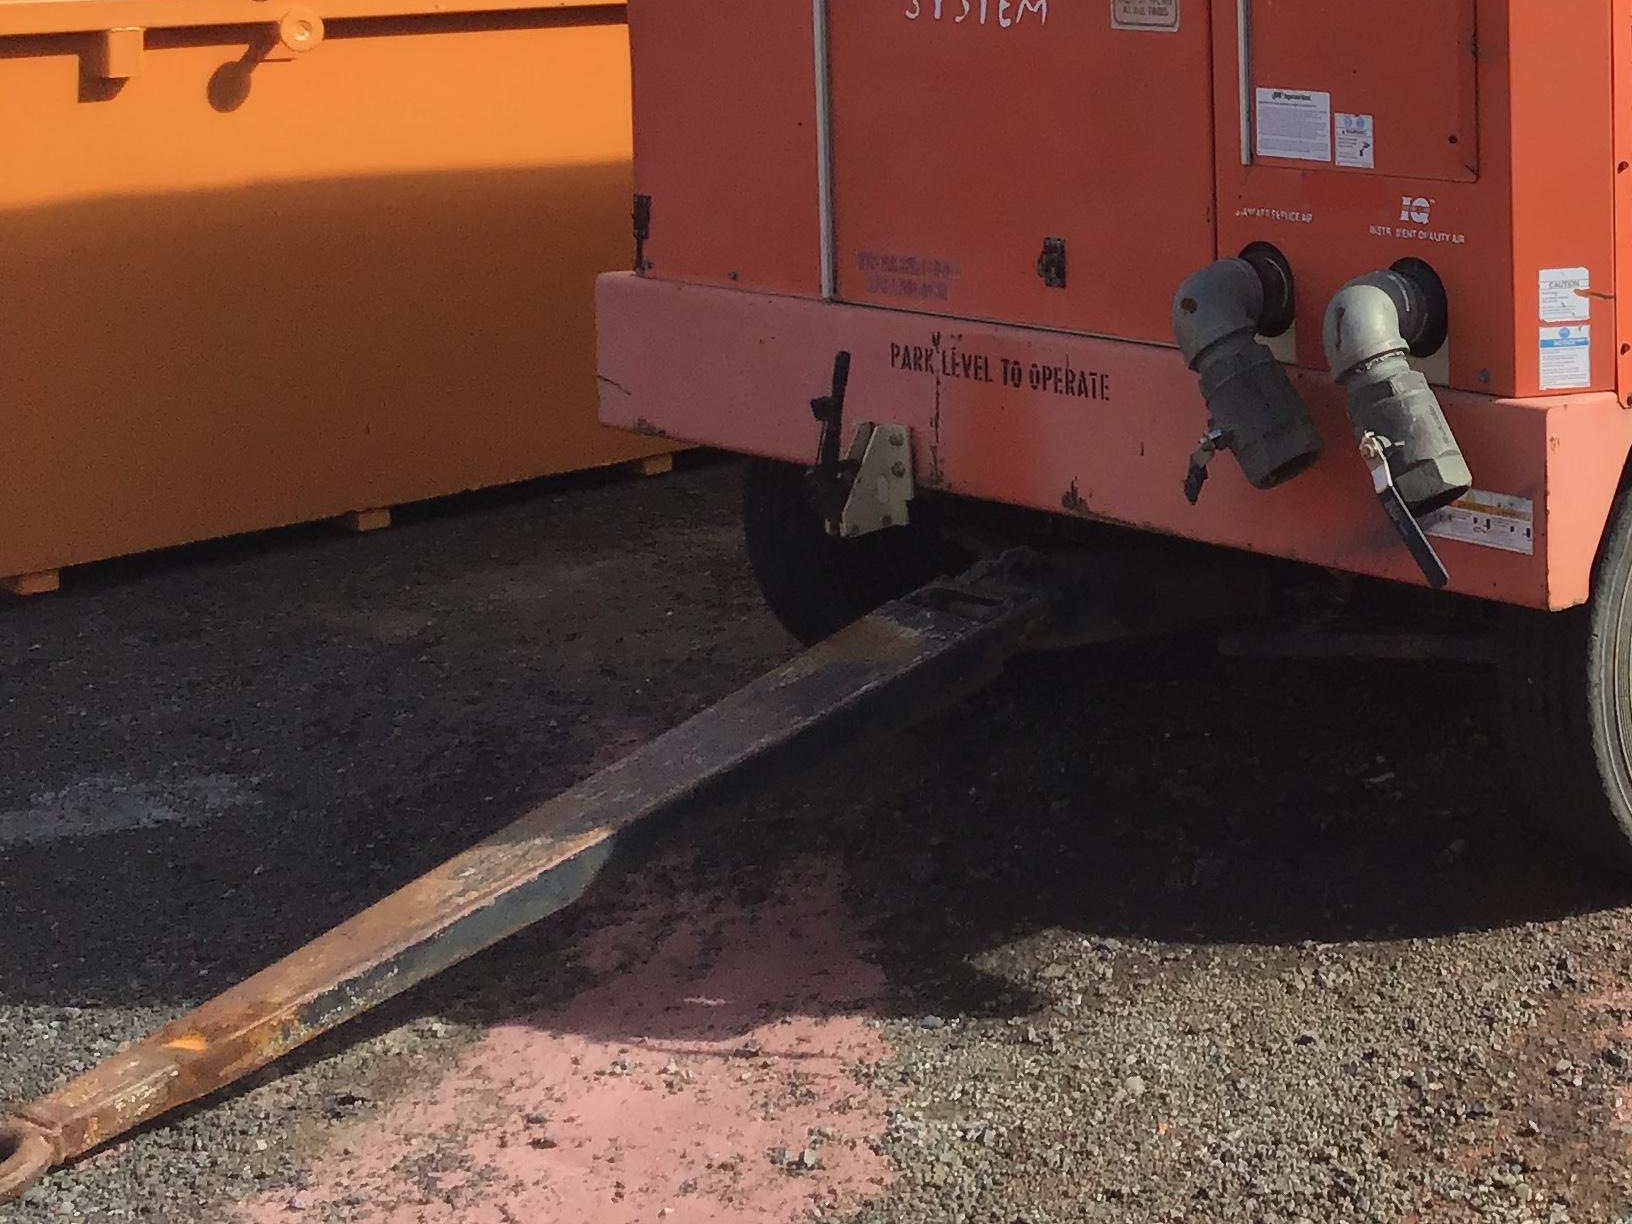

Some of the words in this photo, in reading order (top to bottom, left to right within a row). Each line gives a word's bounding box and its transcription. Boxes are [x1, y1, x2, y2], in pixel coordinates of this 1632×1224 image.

[1548, 279, 1580, 289] CAUTION
[891, 342, 935, 375] PARK
[941, 347, 993, 383] LEVEL
[1001, 357, 1023, 389] TO
[1029, 361, 1111, 401] OPERATE
